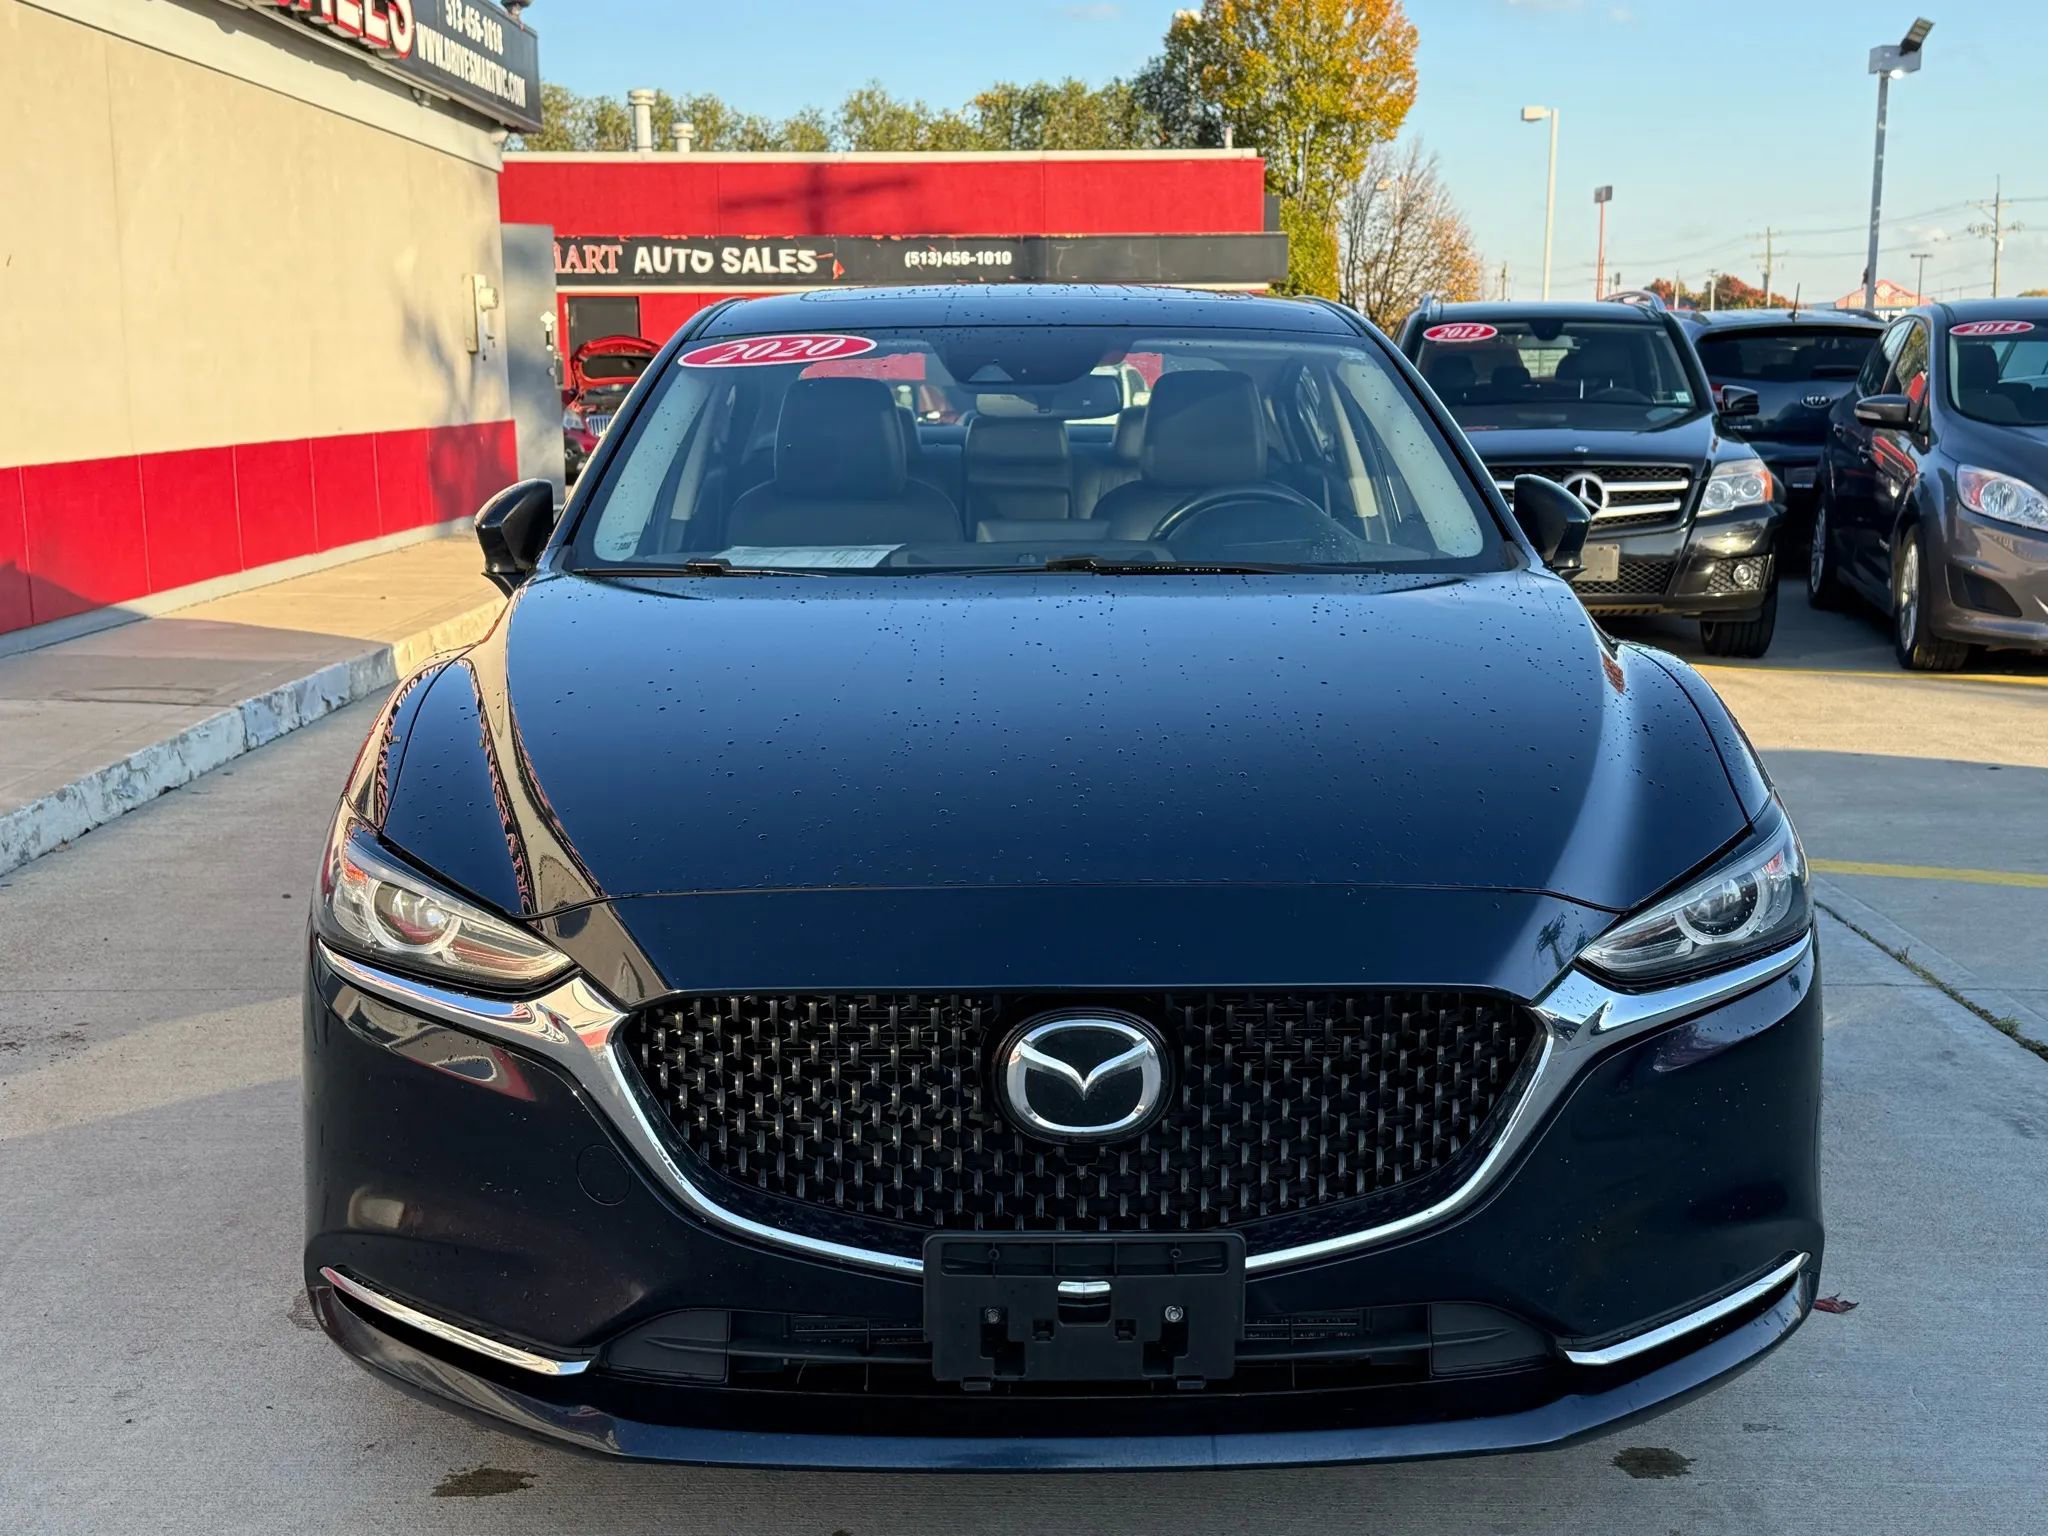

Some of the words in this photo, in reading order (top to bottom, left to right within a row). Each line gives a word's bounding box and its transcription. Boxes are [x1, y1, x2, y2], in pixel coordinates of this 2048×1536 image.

[634, 246, 714, 274] AUTO
[721, 246, 818, 274] SALES
[904, 251, 1012, 268] (513)456-1010
[704, 338, 847, 364] 2020
